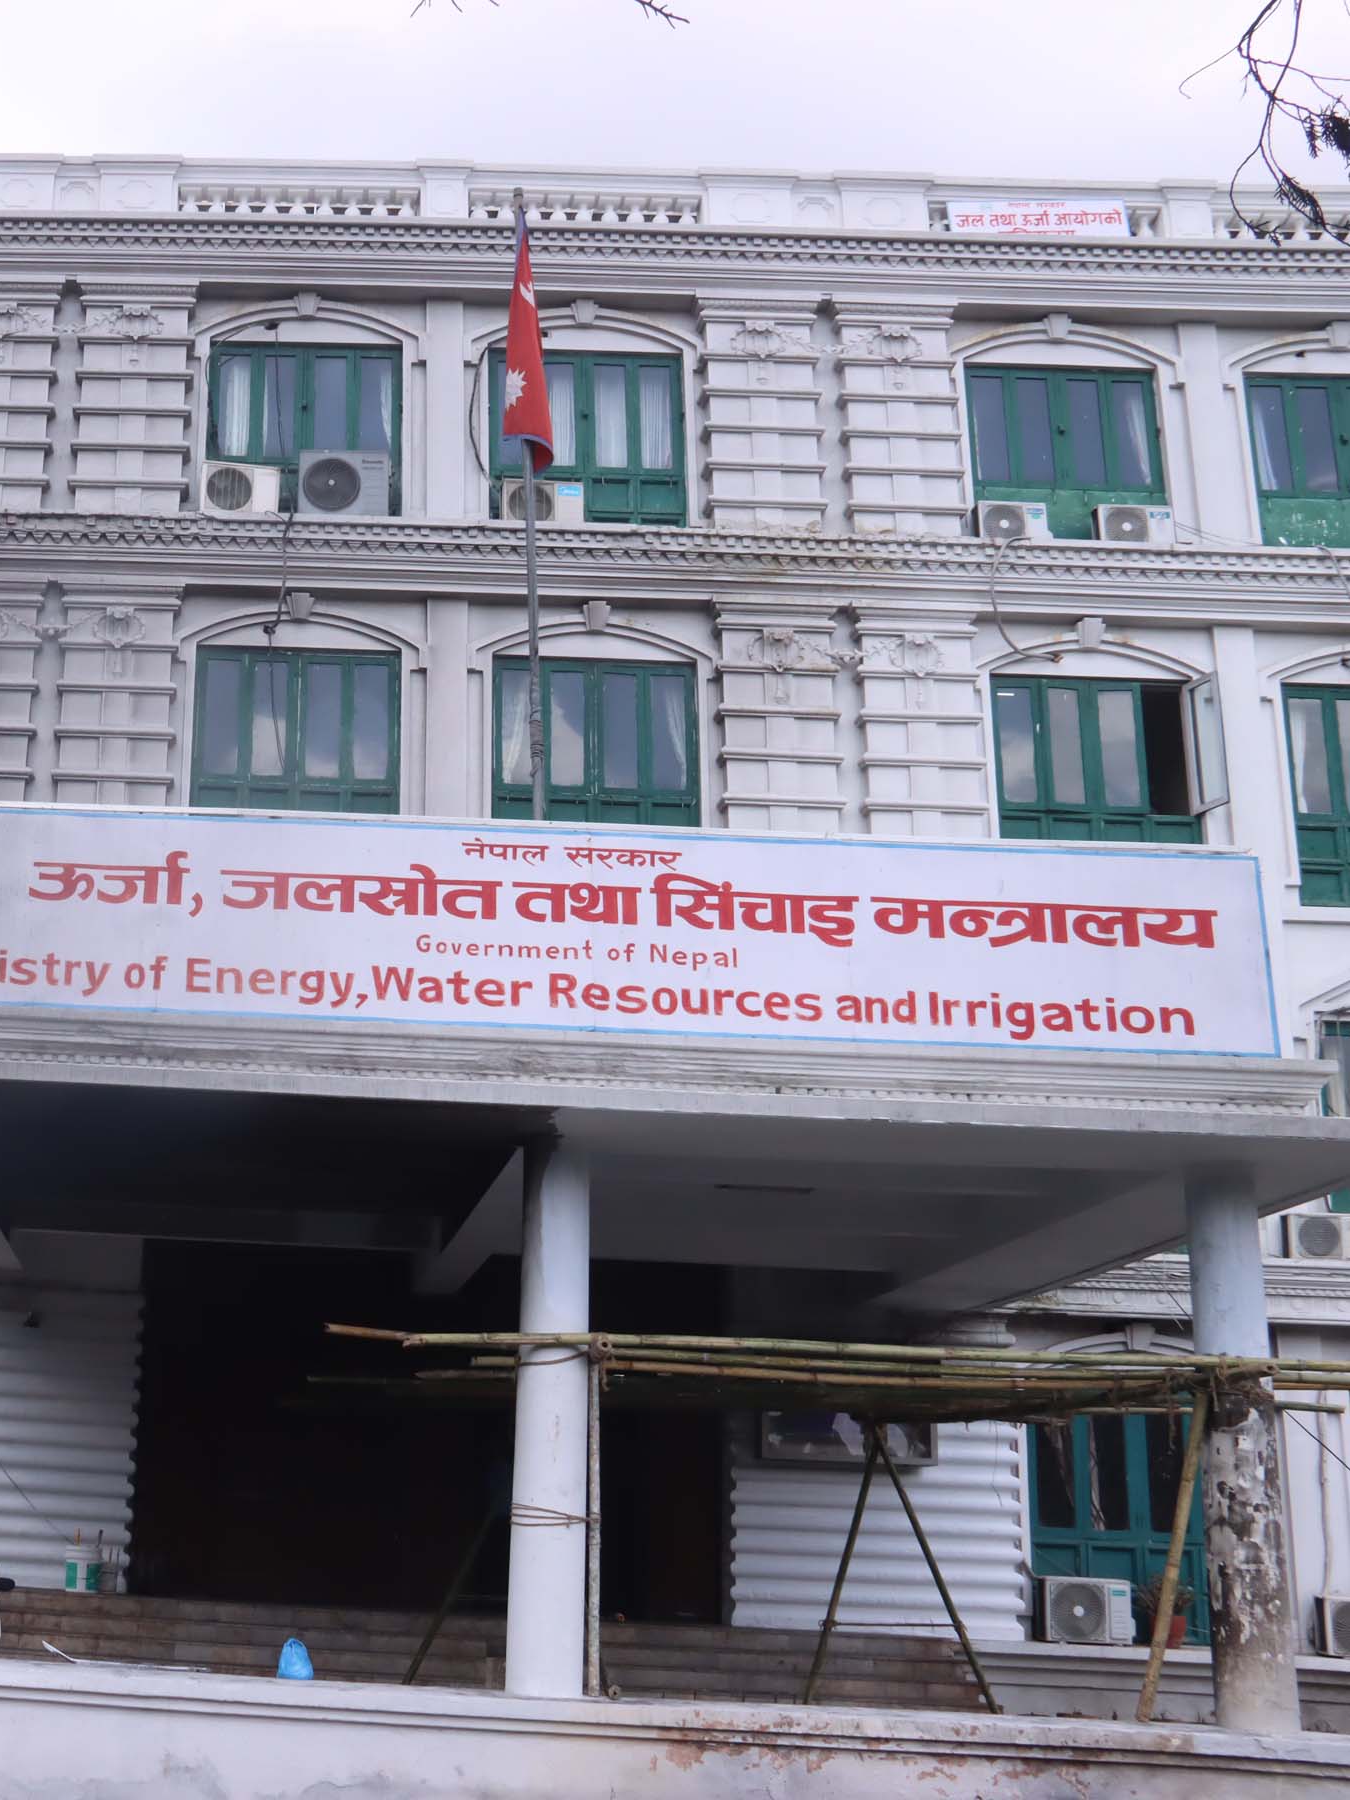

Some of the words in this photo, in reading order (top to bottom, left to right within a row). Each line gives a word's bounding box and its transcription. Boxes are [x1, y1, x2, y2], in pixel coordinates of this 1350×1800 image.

[954, 214, 985, 228] जल
[989, 212, 1018, 228] तथा
[461, 837, 550, 865] नेपाल
[563, 846, 682, 870] सरकार
[28, 850, 204, 918] ऊर्जा,
[219, 862, 505, 922] जलस्रोत
[511, 880, 643, 927] तथा
[649, 872, 860, 947] सिंचाइ
[869, 895, 1220, 950] मन्त्रालय
[415, 932, 594, 961] Government
[606, 942, 636, 962] of
[649, 943, 739, 971] Nepal
[123, 954, 169, 991] of
[548, 971, 825, 1023] Resources
[835, 990, 918, 1025] and
[928, 991, 1196, 1042] Irrigation
